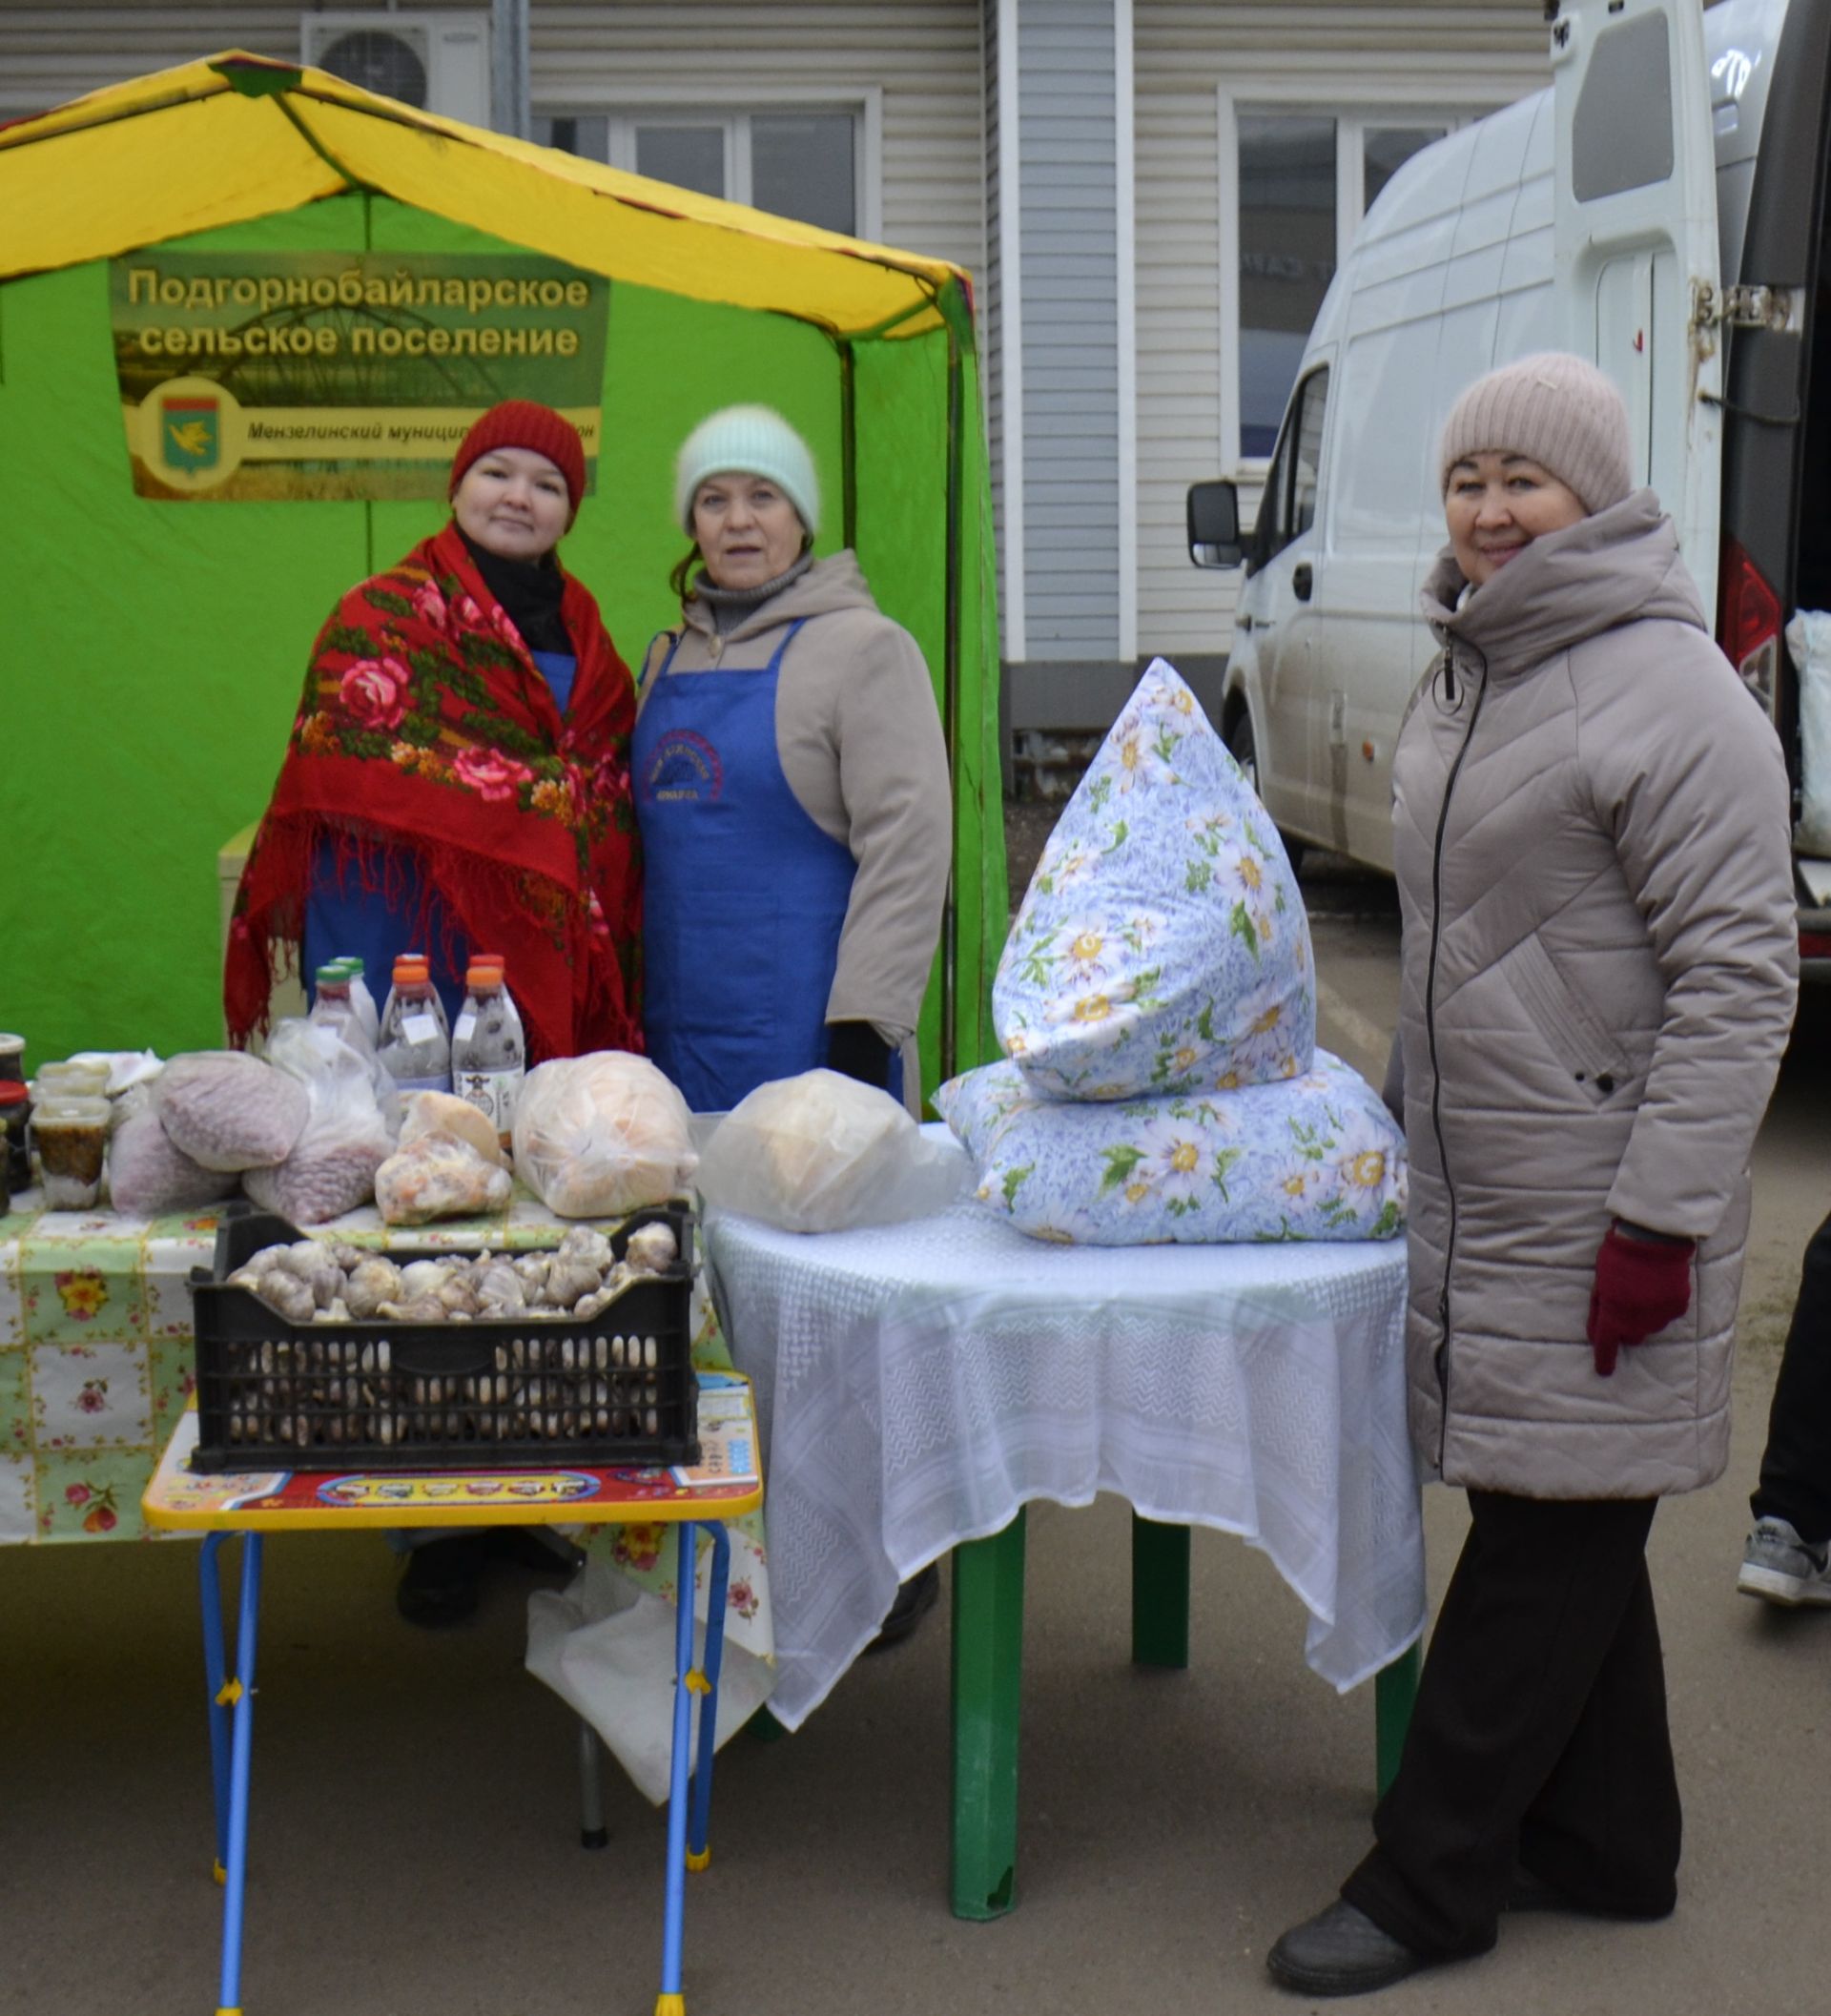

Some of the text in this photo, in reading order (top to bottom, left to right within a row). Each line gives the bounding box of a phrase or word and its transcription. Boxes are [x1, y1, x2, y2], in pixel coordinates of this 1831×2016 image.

[128, 268, 590, 313] Подгорнобайларское
[138, 324, 579, 357] сельское поселение
[248, 422, 469, 443] Мензелинский муницип
